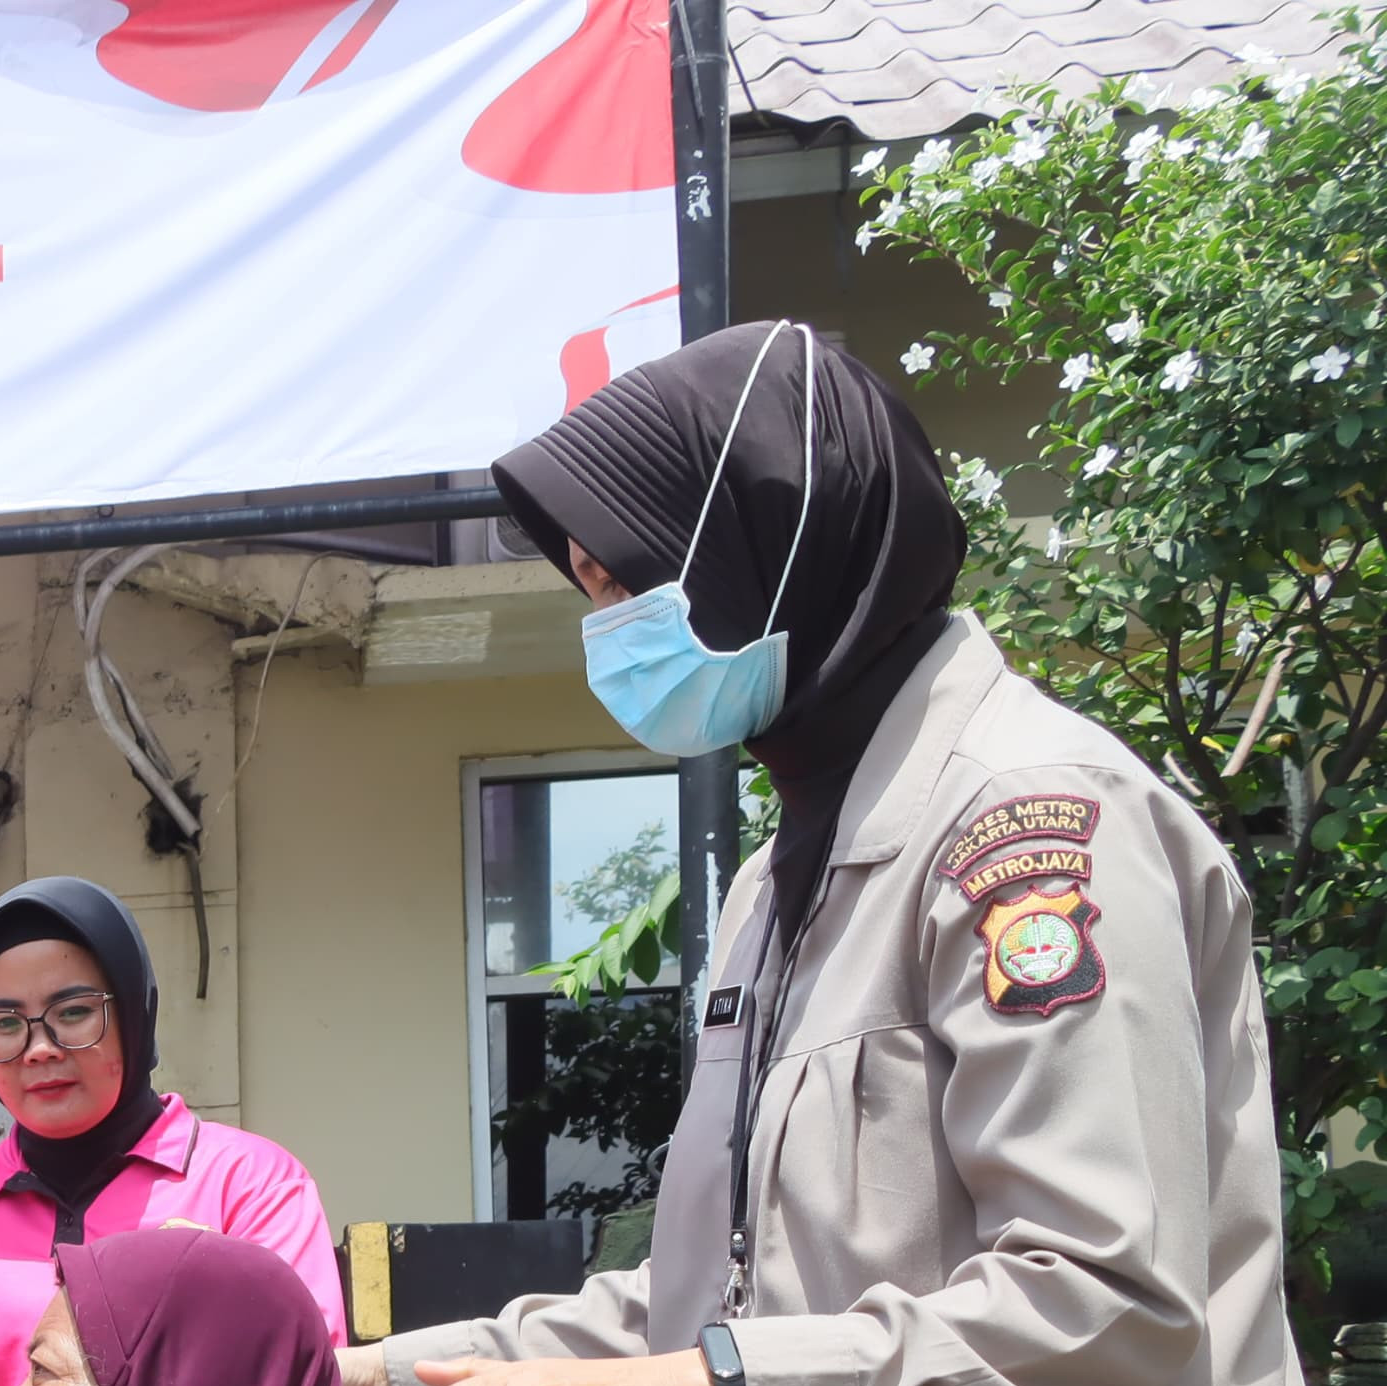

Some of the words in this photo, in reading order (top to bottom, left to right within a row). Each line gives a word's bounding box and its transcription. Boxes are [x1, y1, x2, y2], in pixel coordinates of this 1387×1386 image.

[1015, 800, 1088, 819] METRO
[951, 821, 1022, 869] JAKARTA
[1023, 815, 1082, 833] UTARA
